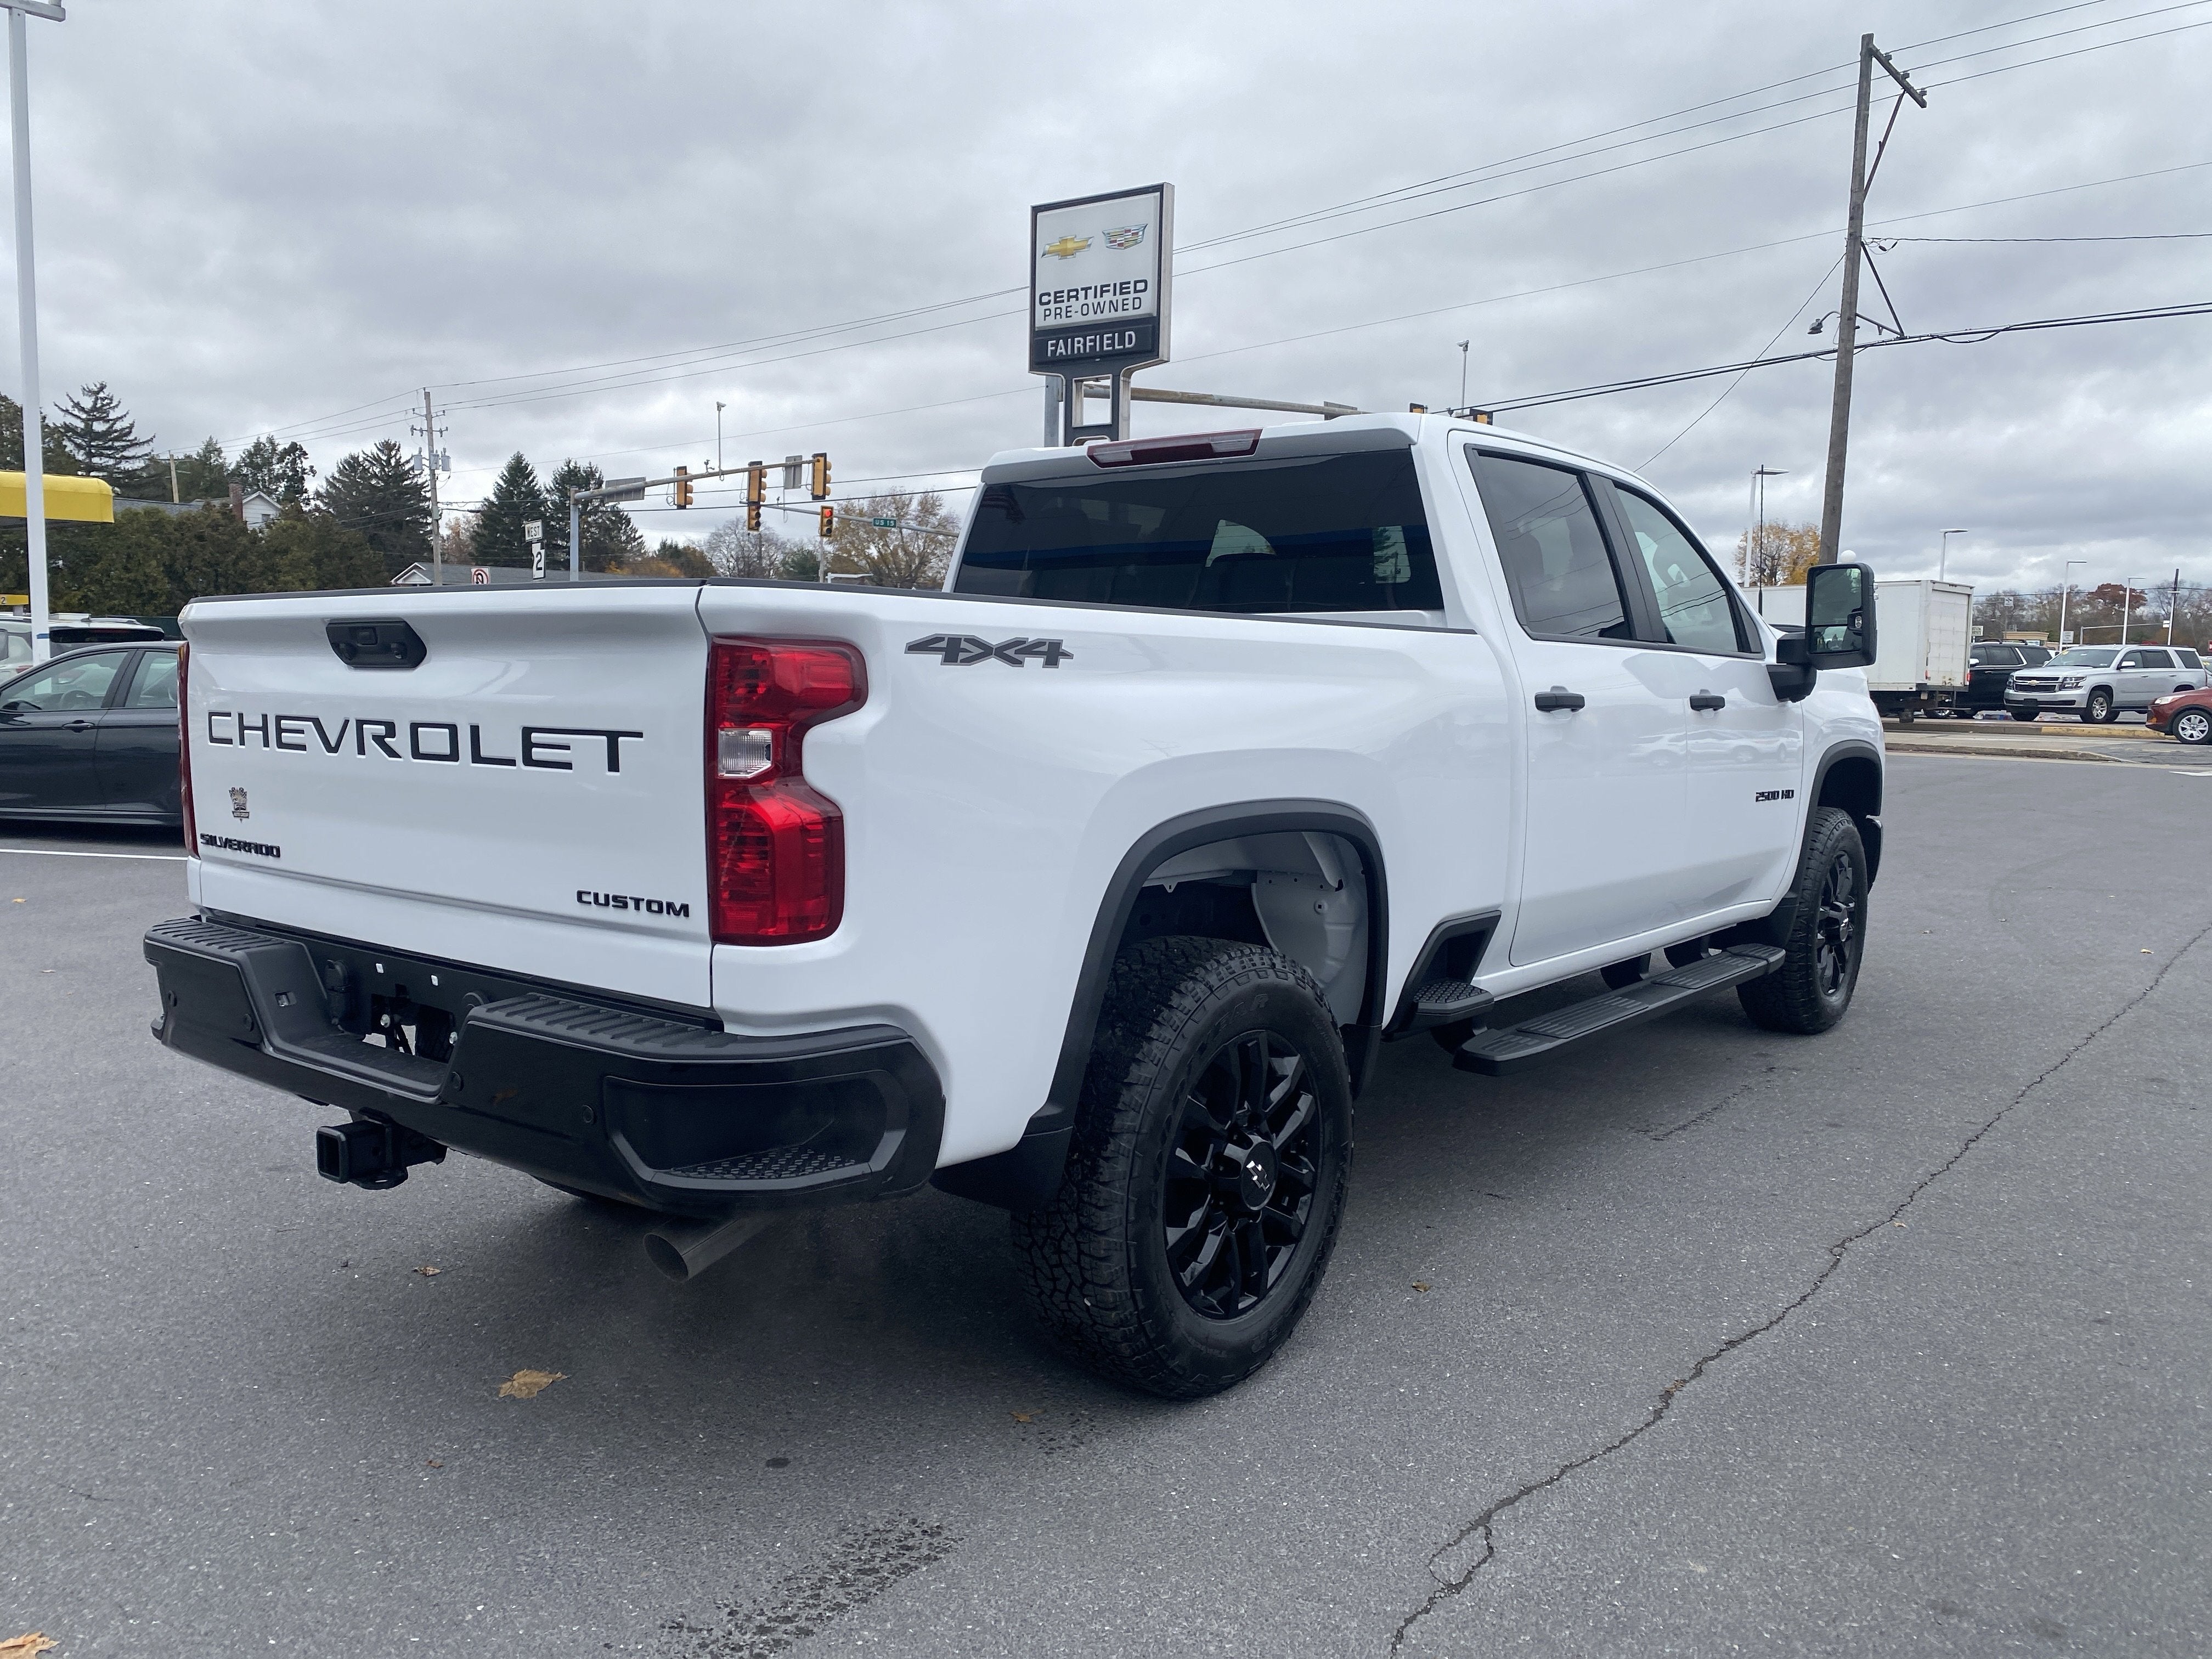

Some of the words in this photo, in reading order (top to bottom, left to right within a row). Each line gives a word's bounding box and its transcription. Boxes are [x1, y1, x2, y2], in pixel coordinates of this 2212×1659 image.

[1039, 279, 1148, 306] CERTIFIED
[1043, 296, 1142, 321] PRE-OWNED
[1047, 330, 1136, 357] FAIRFIELD
[527, 526, 540, 537] WEST
[535, 551, 543, 571] 2
[207, 710, 644, 772] CHEVROLET
[1756, 791, 1780, 802] 2500
[1781, 789, 1795, 800] HD
[200, 833, 281, 858] SILVERADO
[577, 890, 690, 917] CUSTOM
